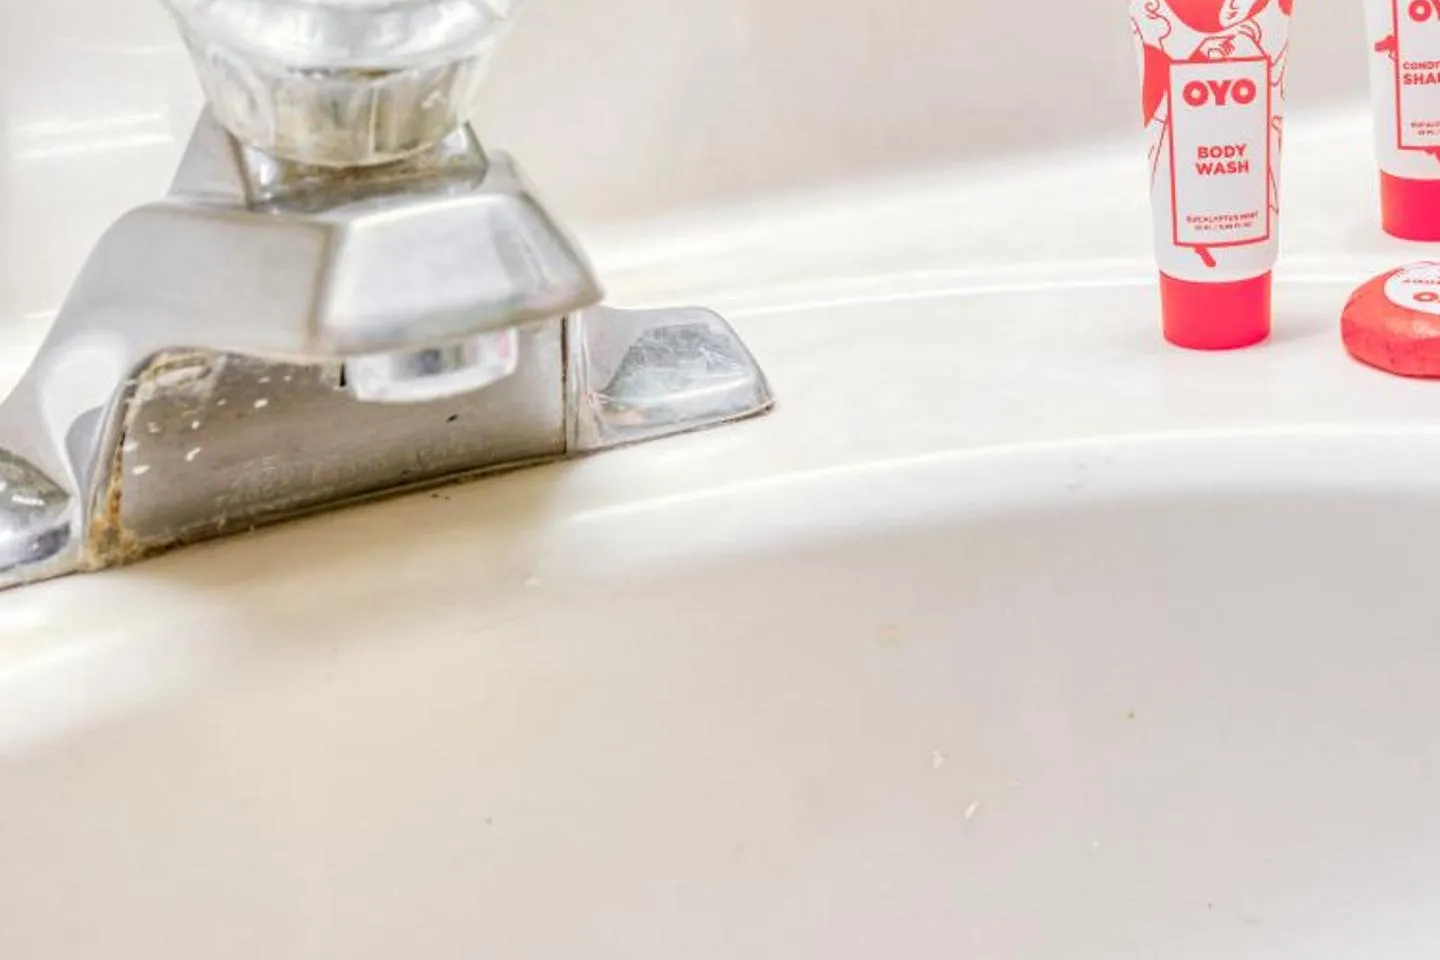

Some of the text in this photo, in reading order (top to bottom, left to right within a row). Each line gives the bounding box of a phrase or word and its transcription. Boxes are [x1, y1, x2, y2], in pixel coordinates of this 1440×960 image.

[1183, 79, 1256, 107] OYO
[1198, 144, 1246, 158] BODY
[1195, 161, 1249, 175] WASH
